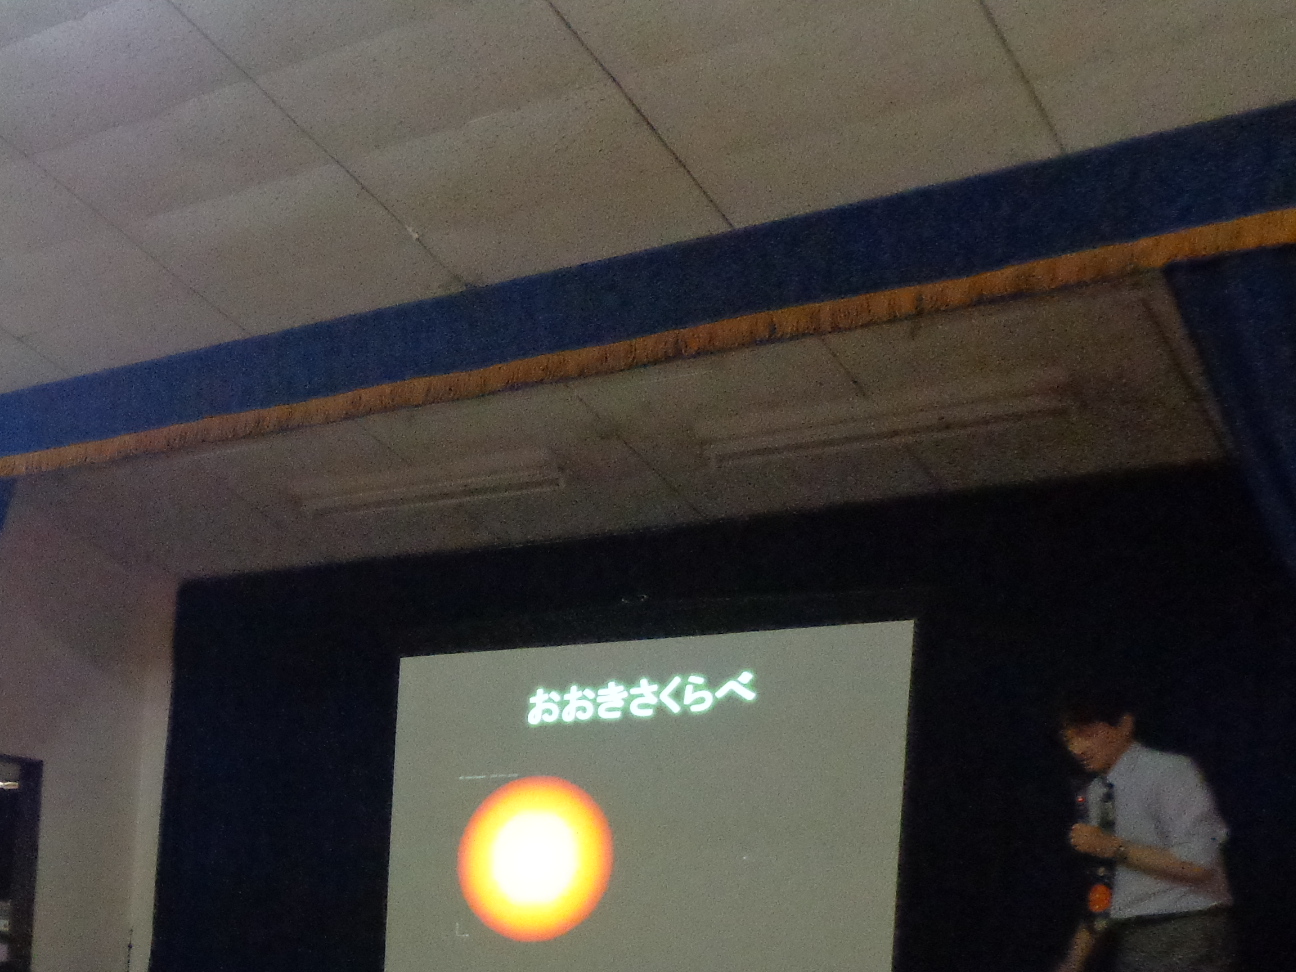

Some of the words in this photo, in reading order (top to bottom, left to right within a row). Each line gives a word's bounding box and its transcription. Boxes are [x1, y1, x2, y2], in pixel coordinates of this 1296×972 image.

[526, 670, 757, 725] おおきさくらべ
